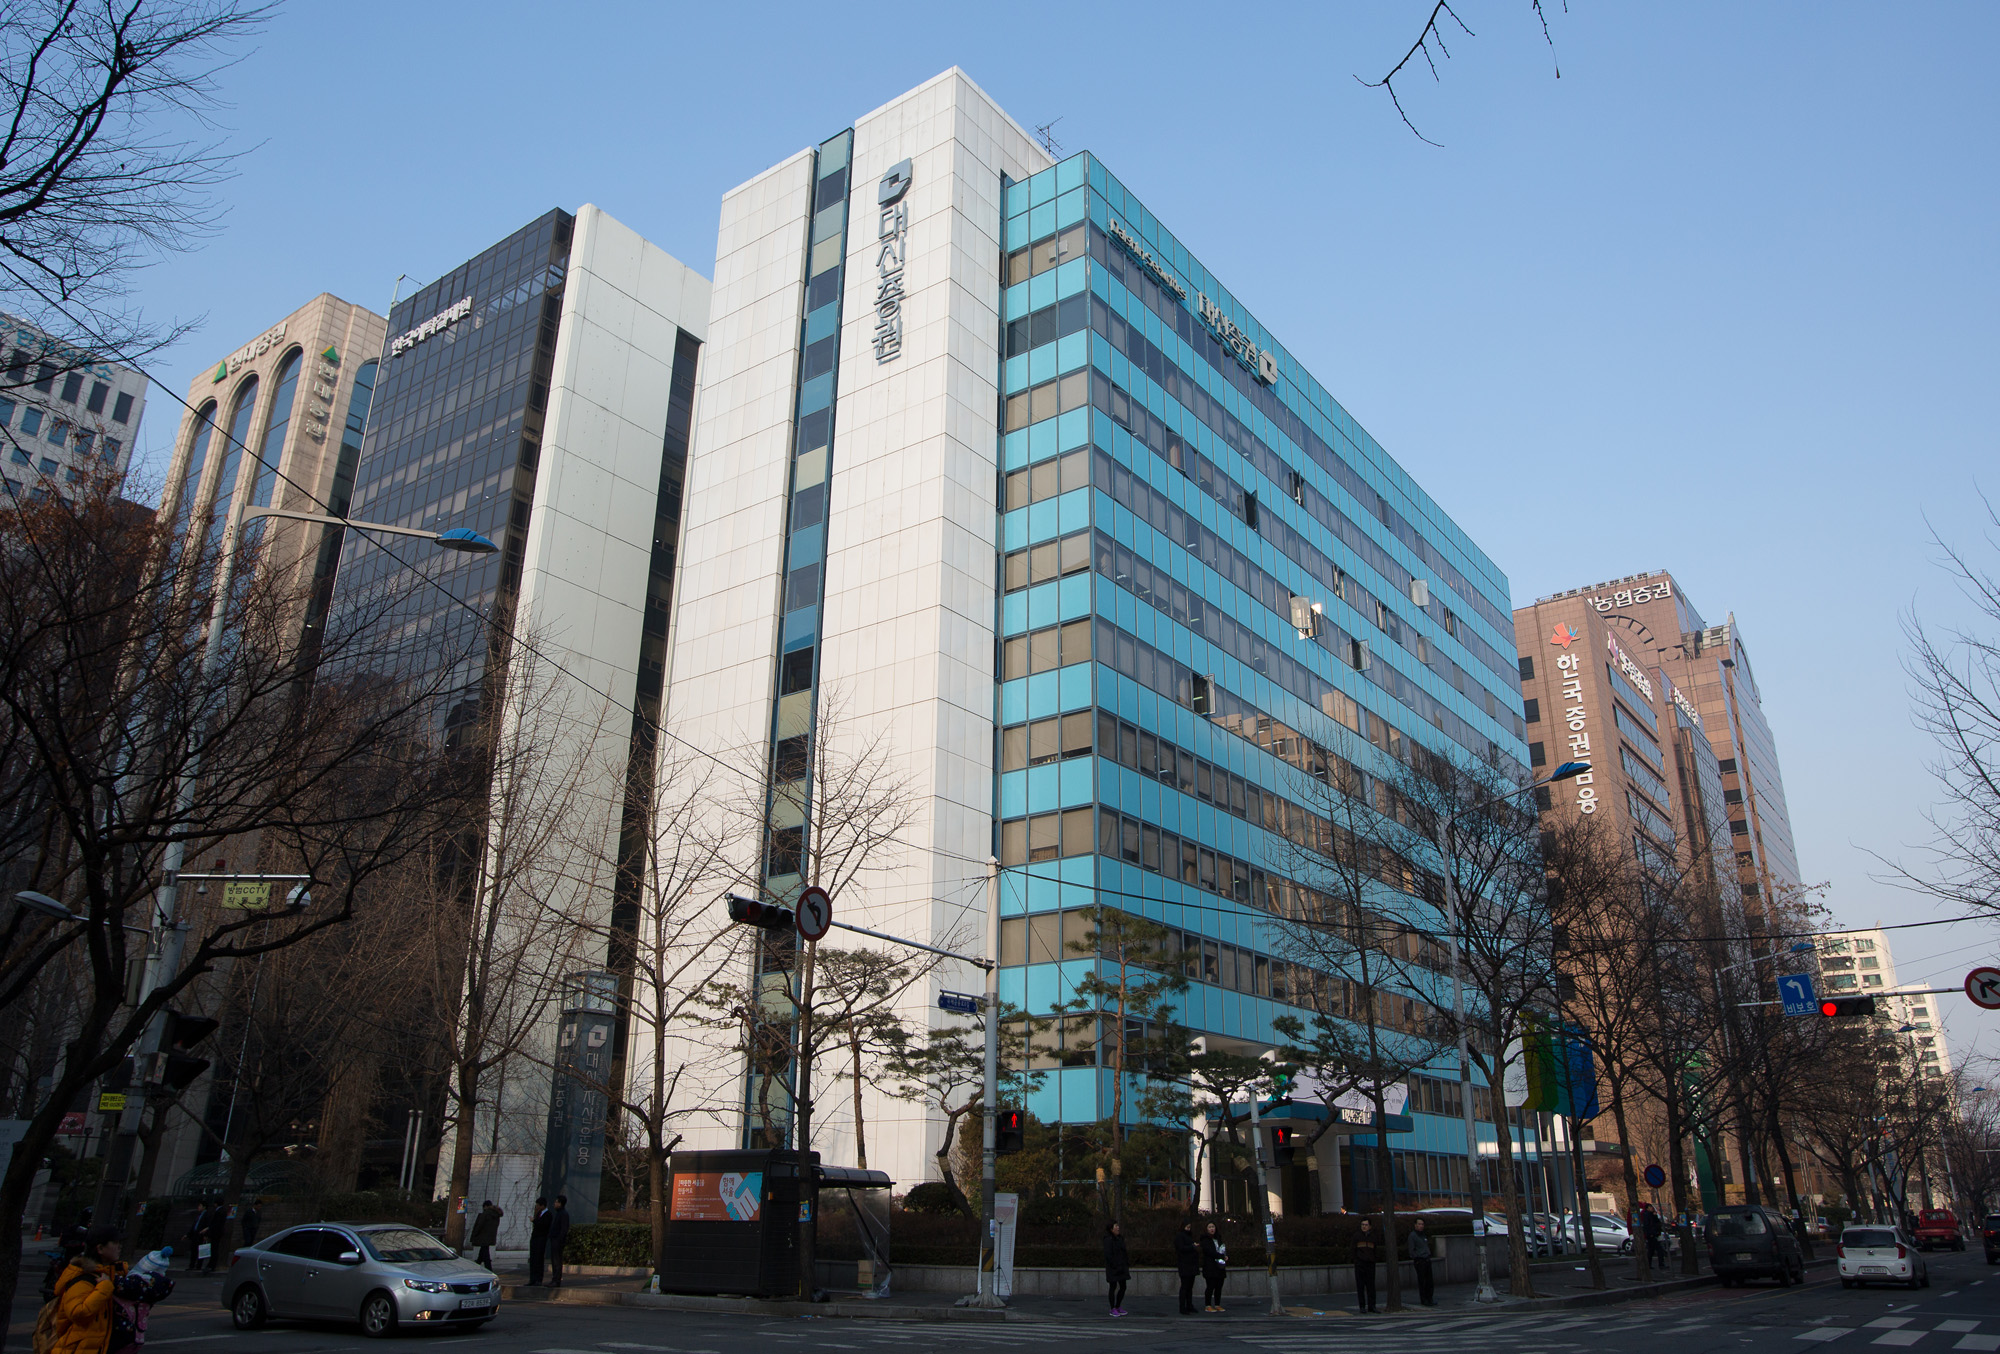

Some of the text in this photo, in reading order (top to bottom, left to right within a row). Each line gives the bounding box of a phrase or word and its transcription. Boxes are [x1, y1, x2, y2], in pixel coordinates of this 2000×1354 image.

[871, 200, 908, 362] 대신증권
[1110, 217, 1187, 301] Daishin Securities
[230, 321, 288, 374] 현대증권
[391, 295, 472, 357] 한국예탁결제원
[1197, 291, 1257, 369] 대신증권
[306, 361, 337, 439] 현대증권
[1588, 580, 1672, 612] 농협증권
[227, 886, 267, 895] 방범CCTV
[1786, 1001, 1816, 1014] 비보호
[722, 1187, 735, 1197] 서울
[723, 1177, 735, 1187] 함께
